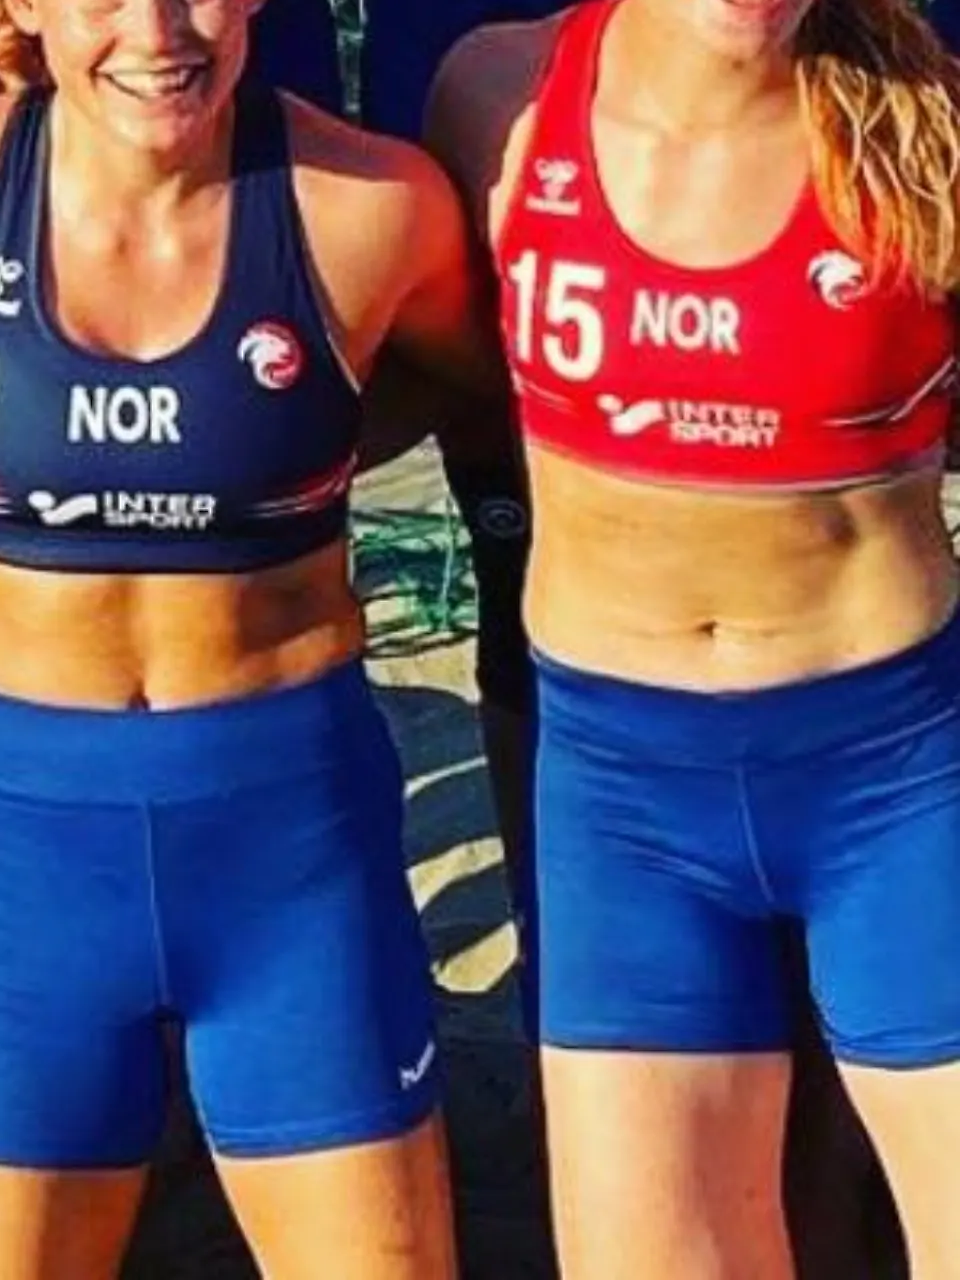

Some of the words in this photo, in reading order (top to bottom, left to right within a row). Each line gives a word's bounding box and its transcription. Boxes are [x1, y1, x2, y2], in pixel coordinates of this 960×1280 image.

[507, 249, 607, 382] 15
[629, 289, 741, 355] NOR
[67, 384, 181, 444] NOR
[666, 399, 781, 429] INTER
[102, 489, 217, 518] INTER
